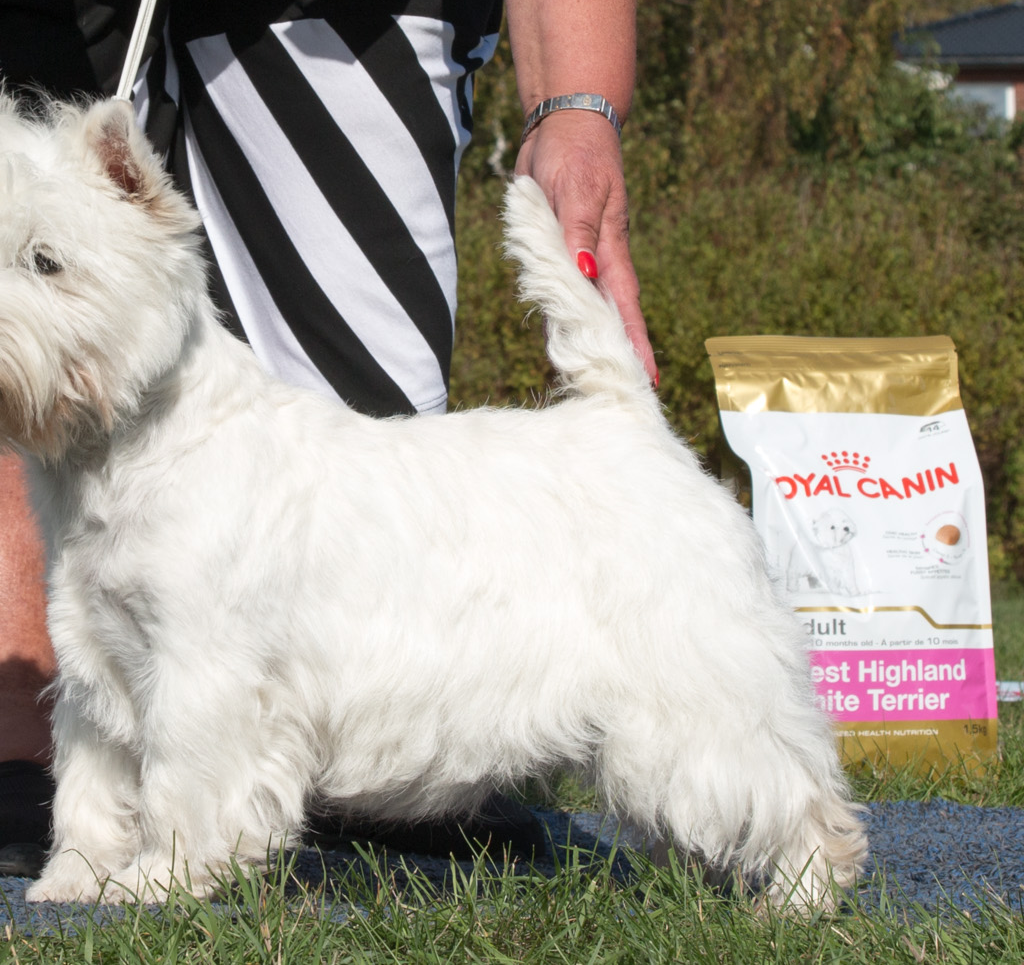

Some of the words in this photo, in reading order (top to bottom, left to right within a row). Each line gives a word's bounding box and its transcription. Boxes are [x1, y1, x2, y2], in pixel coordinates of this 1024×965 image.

[775, 472, 852, 500] OYAL
[856, 462, 960, 500] CANIN
[803, 618, 847, 636] dult
[826, 639, 859, 647] months
[860, 638, 874, 647] old
[889, 638, 912, 648] partir
[914, 638, 925, 647] de
[927, 637, 940, 646] 10
[810, 661, 851, 683] est
[858, 658, 967, 687] Highland
[866, 688, 950, 712] Terrier
[857, 729, 891, 737] HEALTH
[893, 728, 939, 737] NUTRITION
